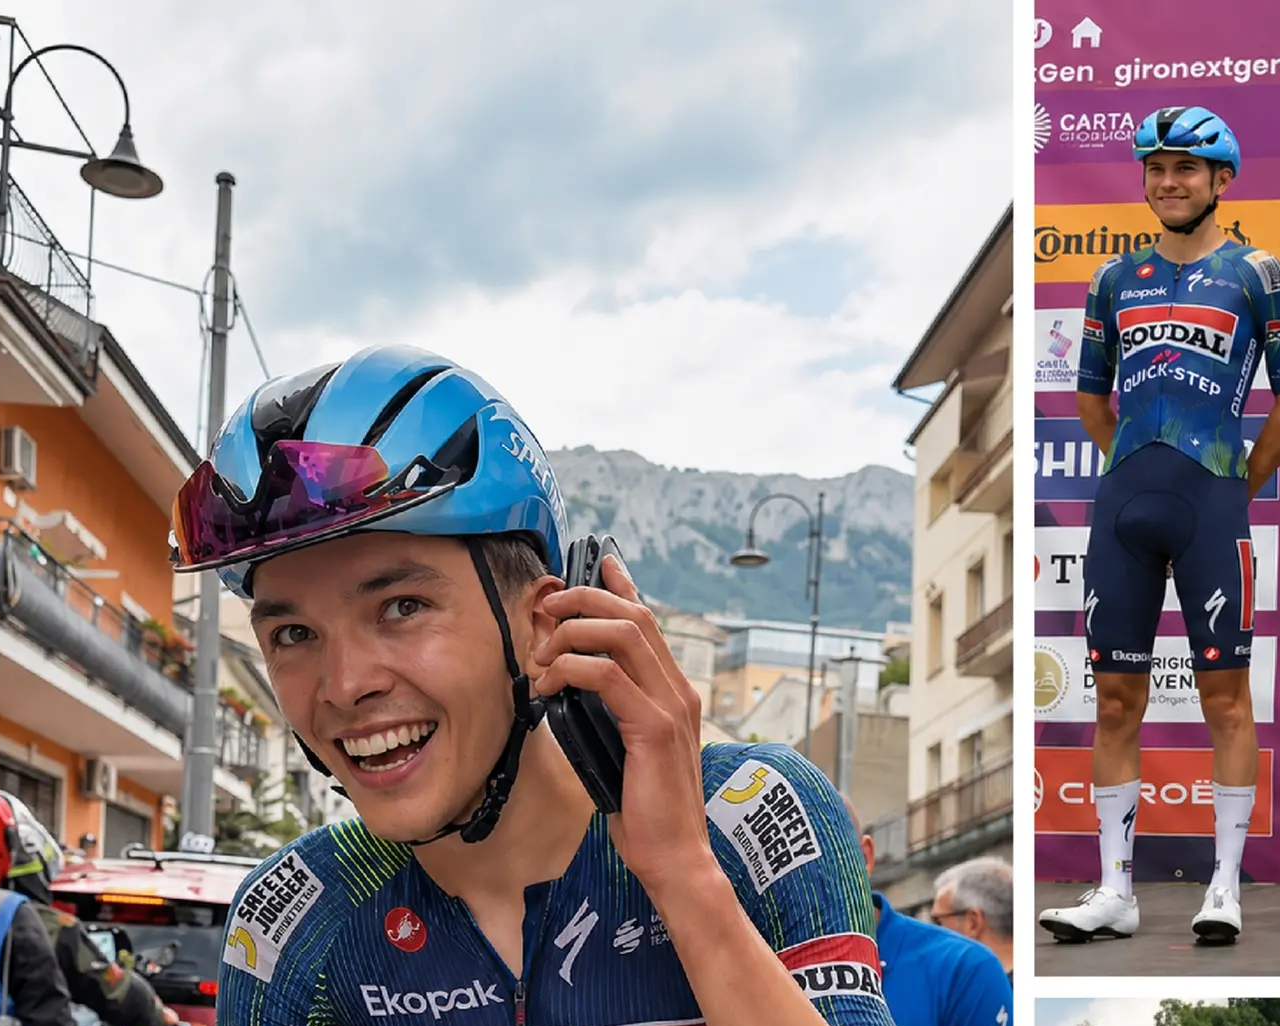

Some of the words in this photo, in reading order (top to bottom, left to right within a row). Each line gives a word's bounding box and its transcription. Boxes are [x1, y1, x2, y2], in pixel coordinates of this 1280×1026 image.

[1060, 112, 1136, 132] CARTA
[1121, 322, 1228, 359] SOUDAL
[762, 782, 817, 858] SAFETY
[237, 855, 297, 923] SAFETY
[359, 978, 506, 1021] Ekopak
